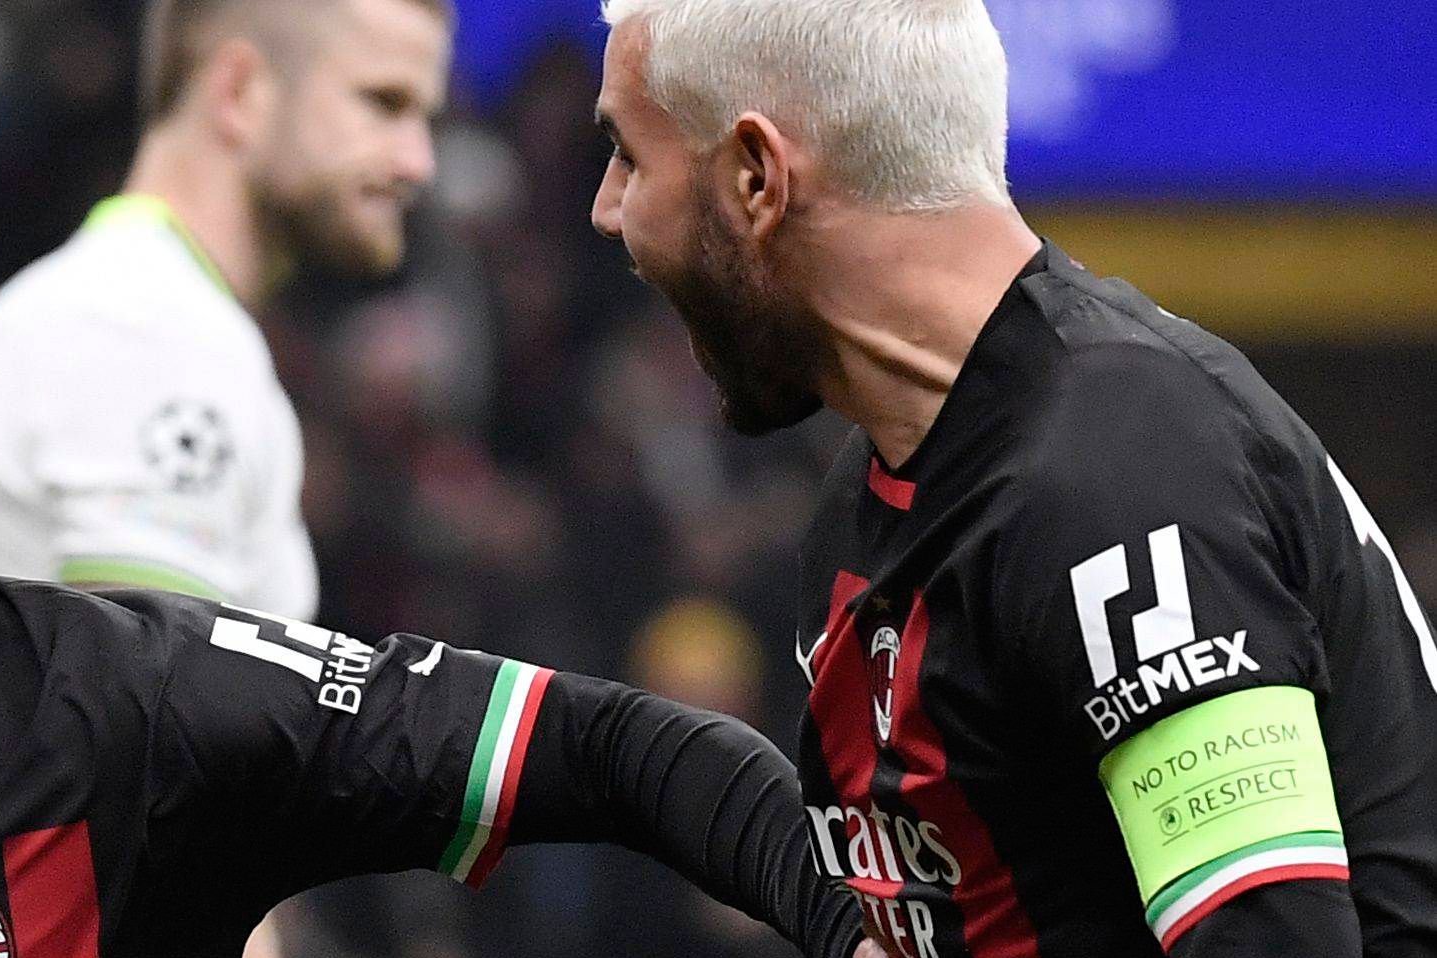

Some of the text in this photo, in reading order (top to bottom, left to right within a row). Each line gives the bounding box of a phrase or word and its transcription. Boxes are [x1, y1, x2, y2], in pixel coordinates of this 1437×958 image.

[1083, 630, 1261, 741] BitMEX
[1132, 724, 1300, 799] NO TO RACISM
[1187, 768, 1298, 819] RESPECT
